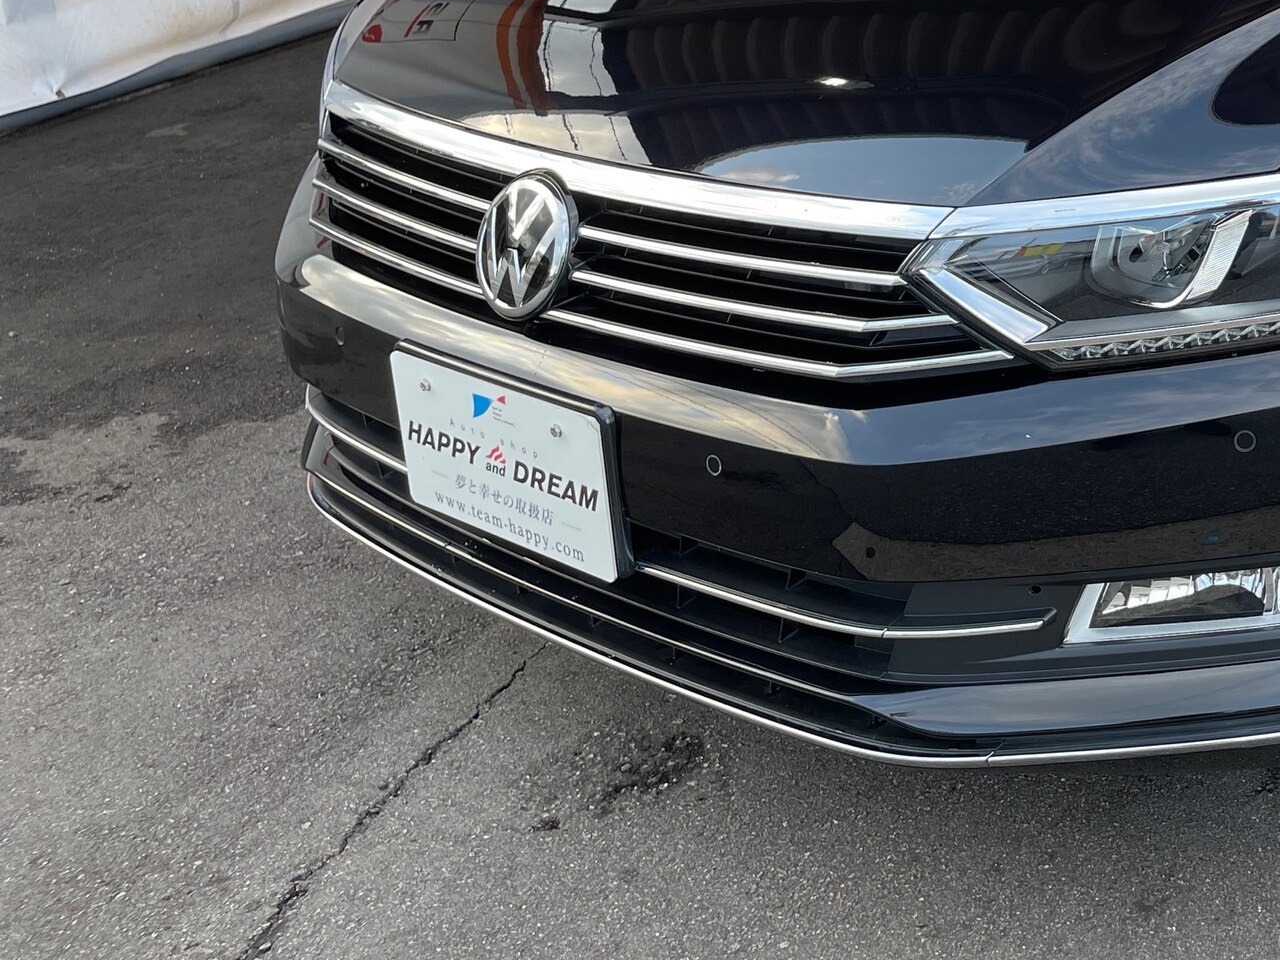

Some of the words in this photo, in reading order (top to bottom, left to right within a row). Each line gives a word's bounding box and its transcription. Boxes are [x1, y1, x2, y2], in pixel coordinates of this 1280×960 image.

[407, 420, 482, 466] HAPPY
[485, 460, 507, 478] and
[512, 460, 599, 513] DREAM
[449, 418, 486, 440] Auto
[499, 437, 540, 461] shop
[433, 490, 586, 564] www.team-happy.com
[454, 473, 555, 527] 夢と幸せの取扱店
